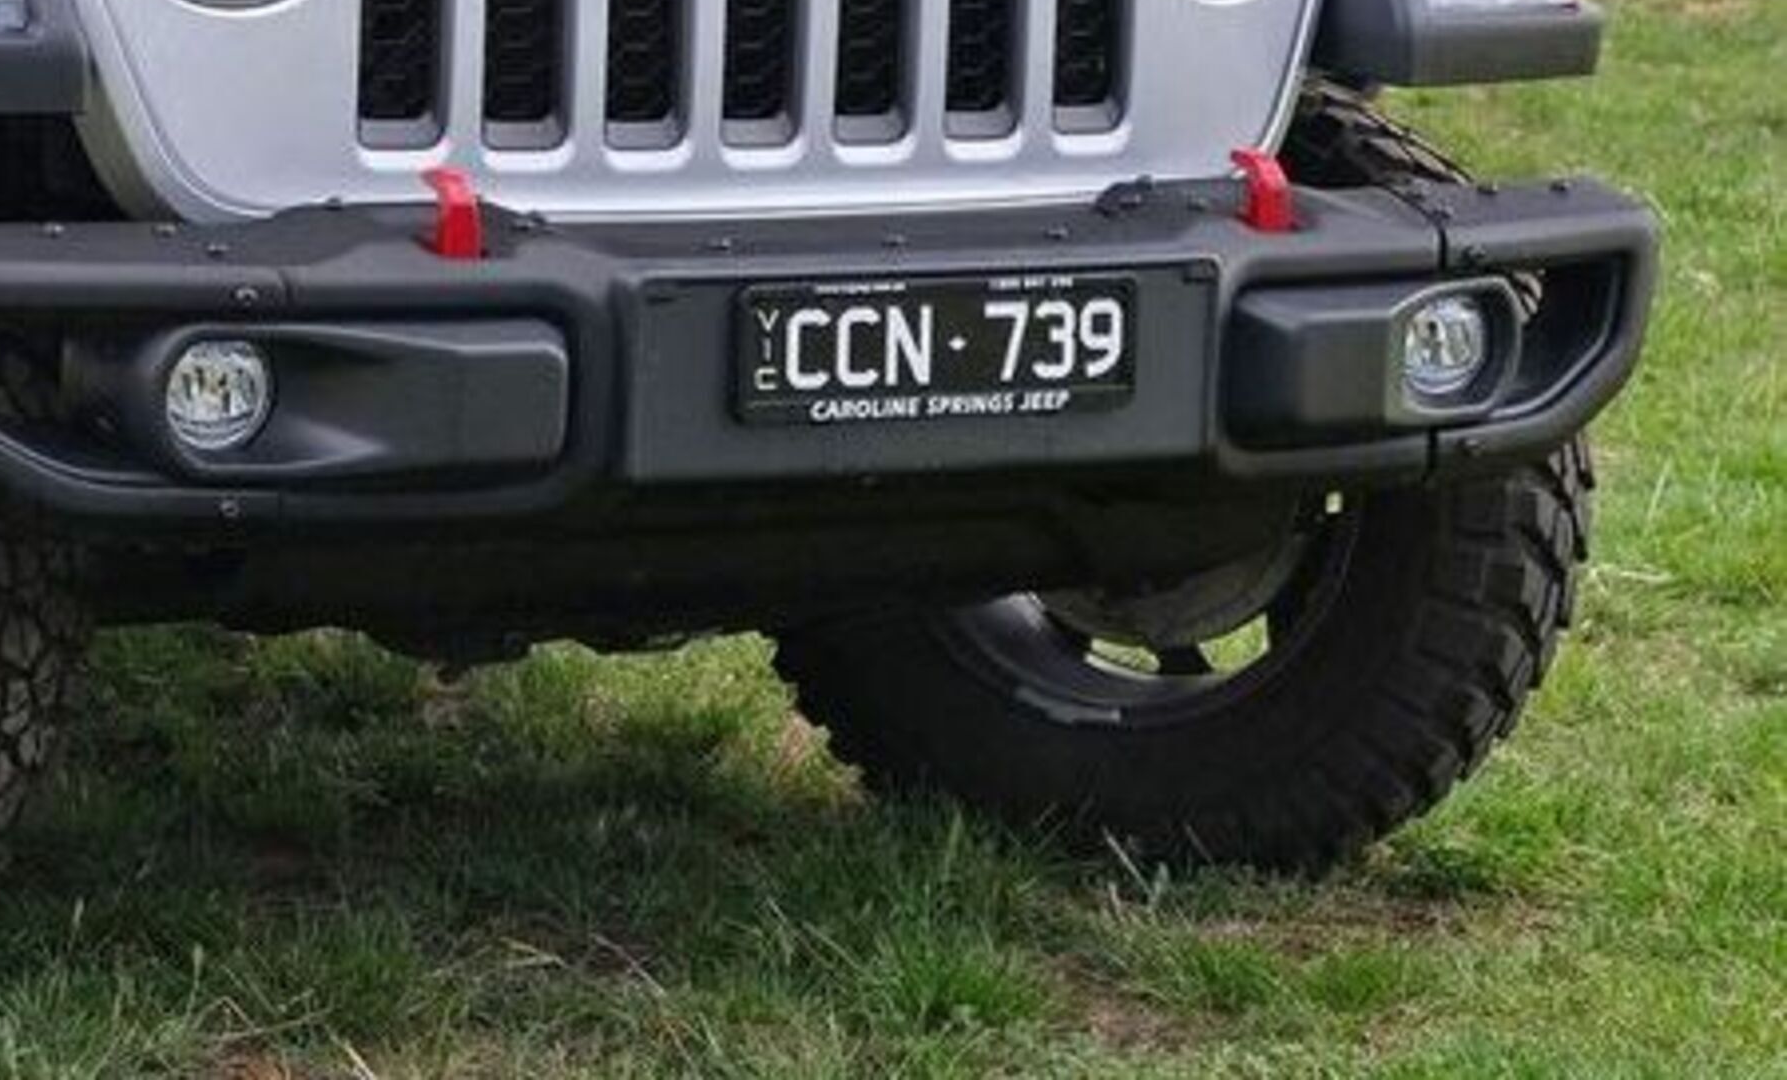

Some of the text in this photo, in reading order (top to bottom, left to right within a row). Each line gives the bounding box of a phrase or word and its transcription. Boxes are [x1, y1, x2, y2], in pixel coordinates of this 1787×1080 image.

[810, 389, 1072, 421] CAROLINE SPRINGS JEEP
